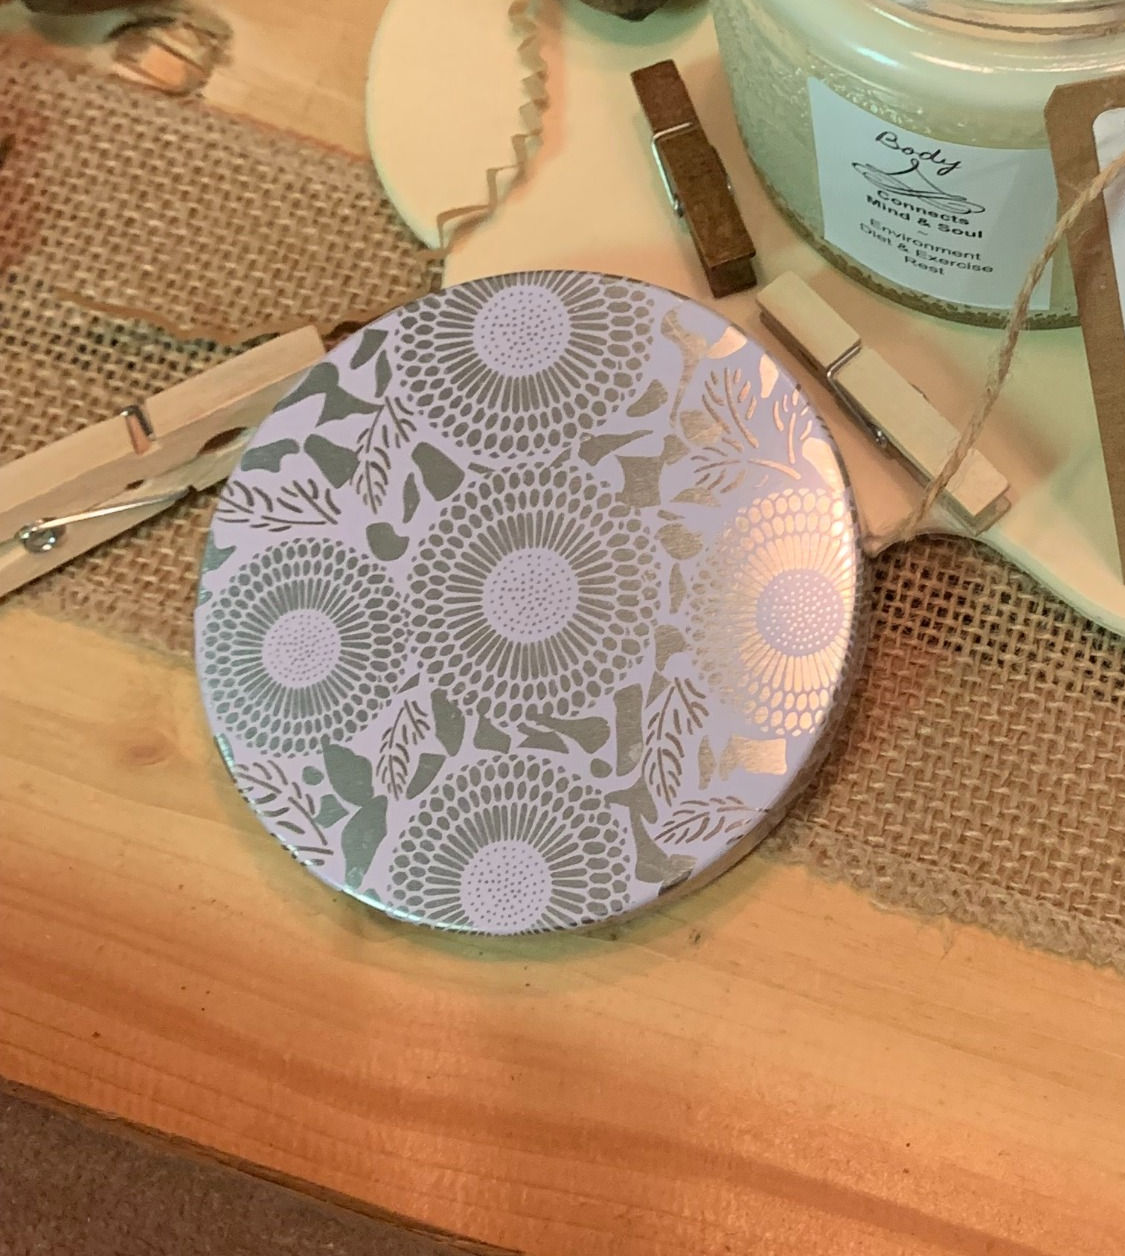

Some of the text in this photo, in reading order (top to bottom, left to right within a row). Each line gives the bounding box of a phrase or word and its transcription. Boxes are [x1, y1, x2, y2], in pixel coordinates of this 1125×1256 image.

[875, 130, 962, 176] Body
[866, 194, 983, 239] Mind & Soul
[877, 189, 970, 226] Connects
[860, 222, 994, 274] Diet & Exercise
[869, 217, 982, 261] Environment
[904, 255, 945, 276] Rest
